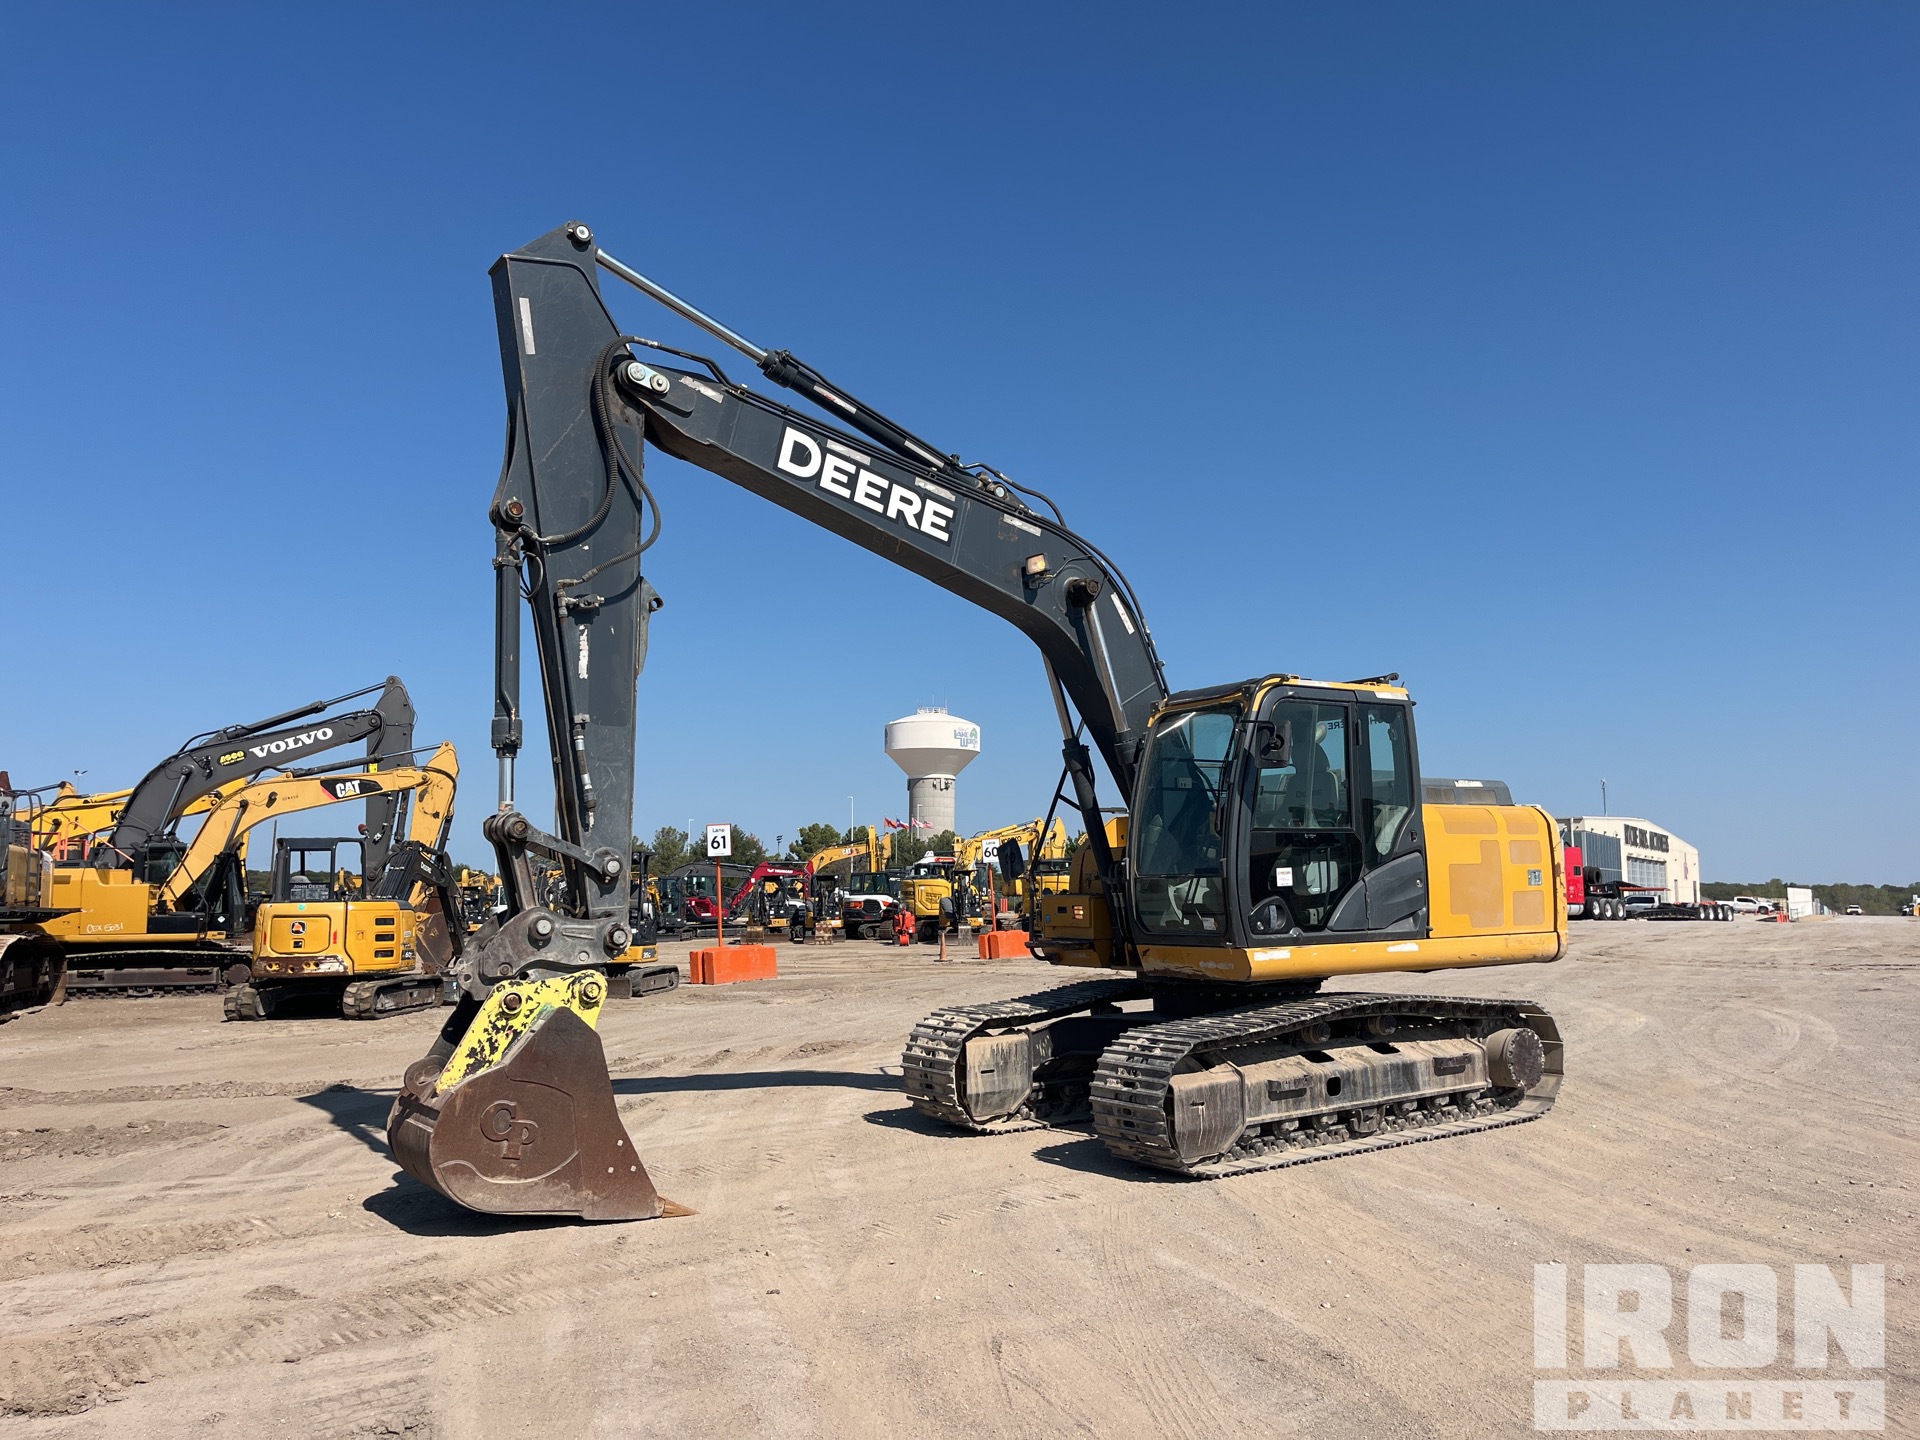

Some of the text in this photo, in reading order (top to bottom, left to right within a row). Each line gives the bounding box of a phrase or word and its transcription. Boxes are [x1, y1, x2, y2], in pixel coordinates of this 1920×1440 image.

[777, 426, 954, 542] DEERE
[249, 727, 333, 758] VOLVO
[335, 780, 361, 798] CAT
[711, 835, 727, 850] 61
[984, 846, 999, 858] 60
